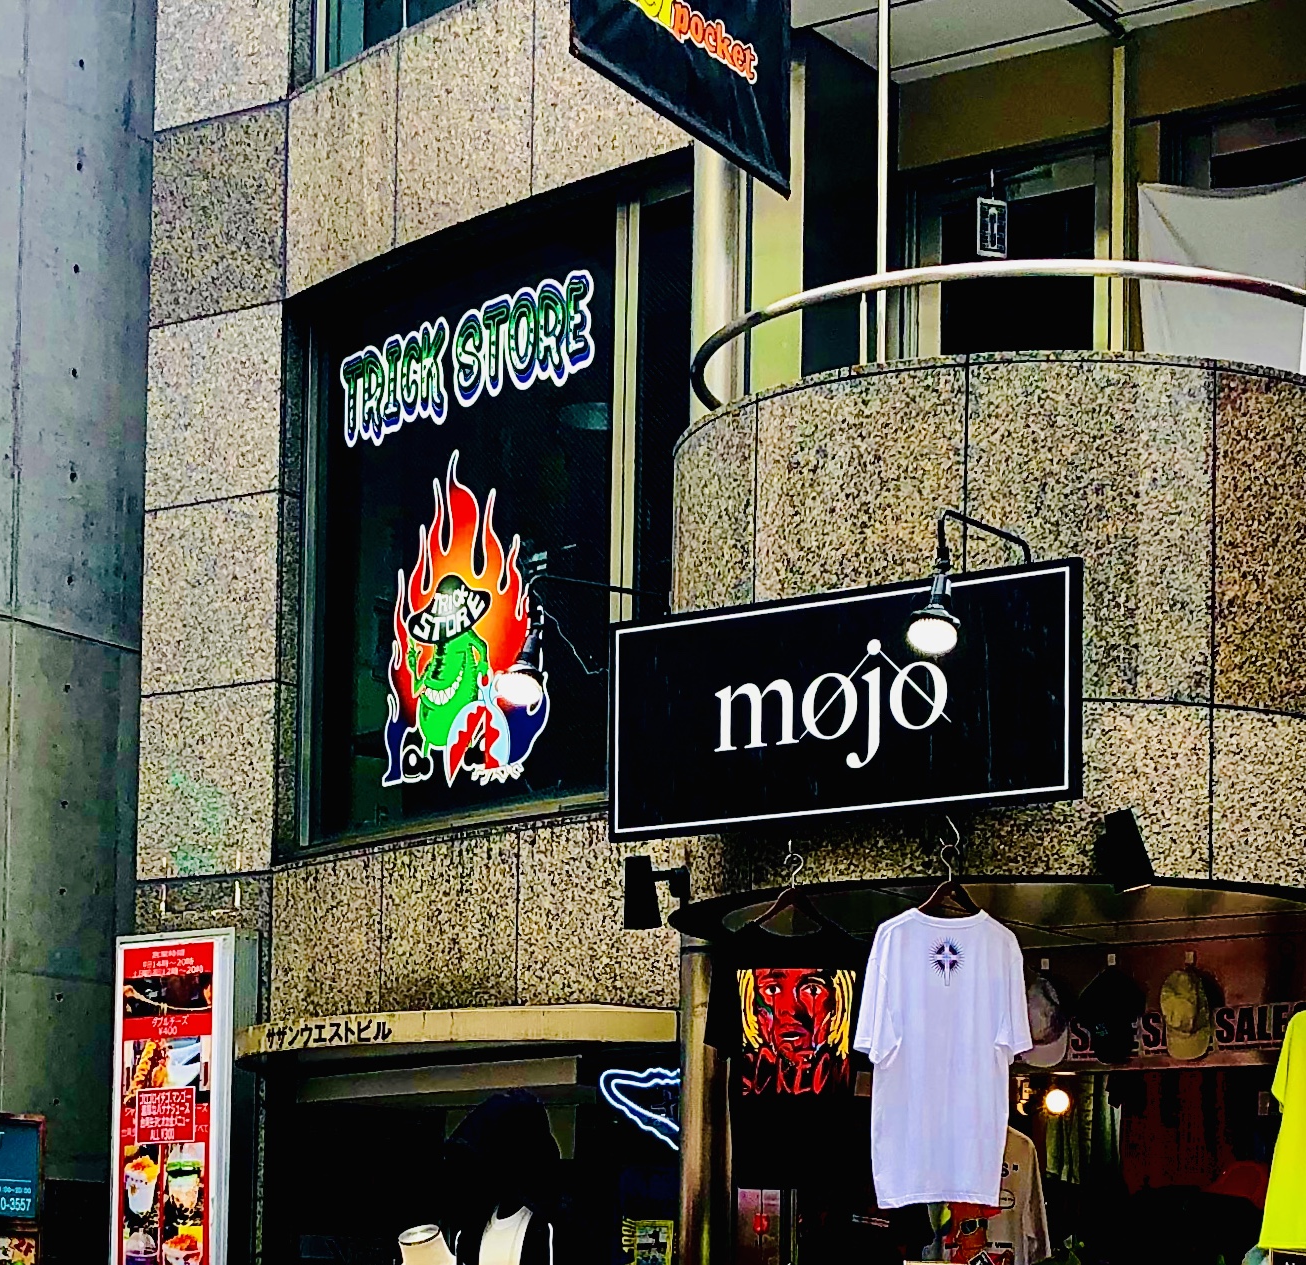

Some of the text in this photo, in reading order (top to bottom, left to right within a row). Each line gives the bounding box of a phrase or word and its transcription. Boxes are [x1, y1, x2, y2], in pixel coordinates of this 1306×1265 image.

[672, 7, 758, 83] pocket
[342, 270, 594, 446] TRICK STORE
[266, 1019, 393, 1049] サザンウエストビル
